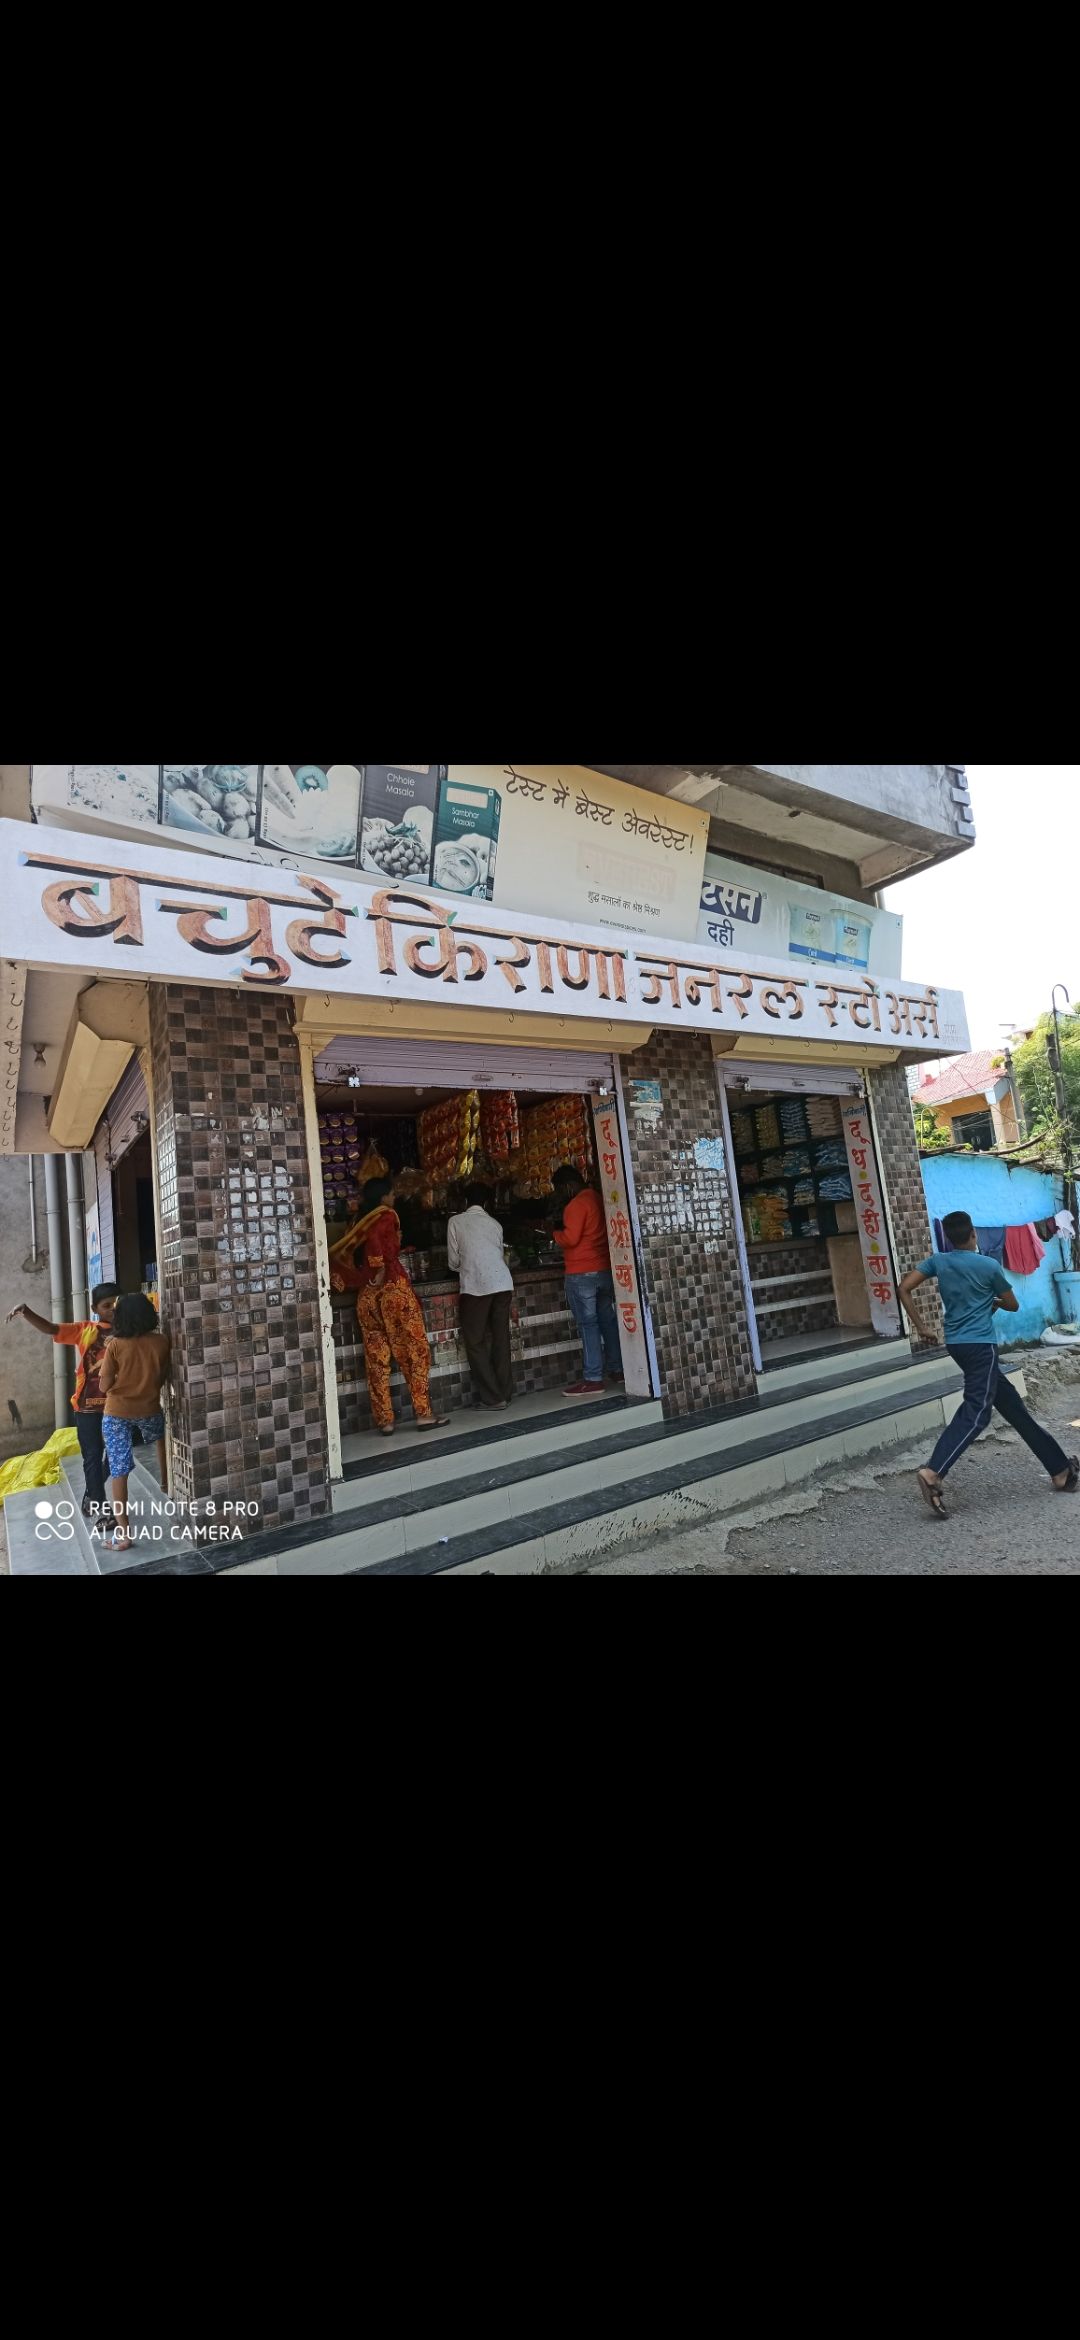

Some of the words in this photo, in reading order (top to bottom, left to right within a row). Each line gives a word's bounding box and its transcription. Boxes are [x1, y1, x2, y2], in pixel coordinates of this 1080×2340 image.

[385, 784, 415, 798] Masala
[386, 772, 416, 787] Chhole
[503, 765, 547, 801] टेस्ट
[552, 778, 570, 808] में
[575, 789, 615, 826] बेस्ट
[451, 807, 480, 819] Sambhar
[452, 817, 476, 829] Masala
[701, 880, 759, 923] टसन
[18, 850, 359, 986] बचुटे
[362, 888, 629, 1004] किराणा
[634, 951, 809, 1020] जनरल
[707, 919, 735, 947] दही
[848, 1120, 871, 1170] दूध
[857, 1182, 880, 1241] दही
[867, 1255, 892, 1305] ताक
